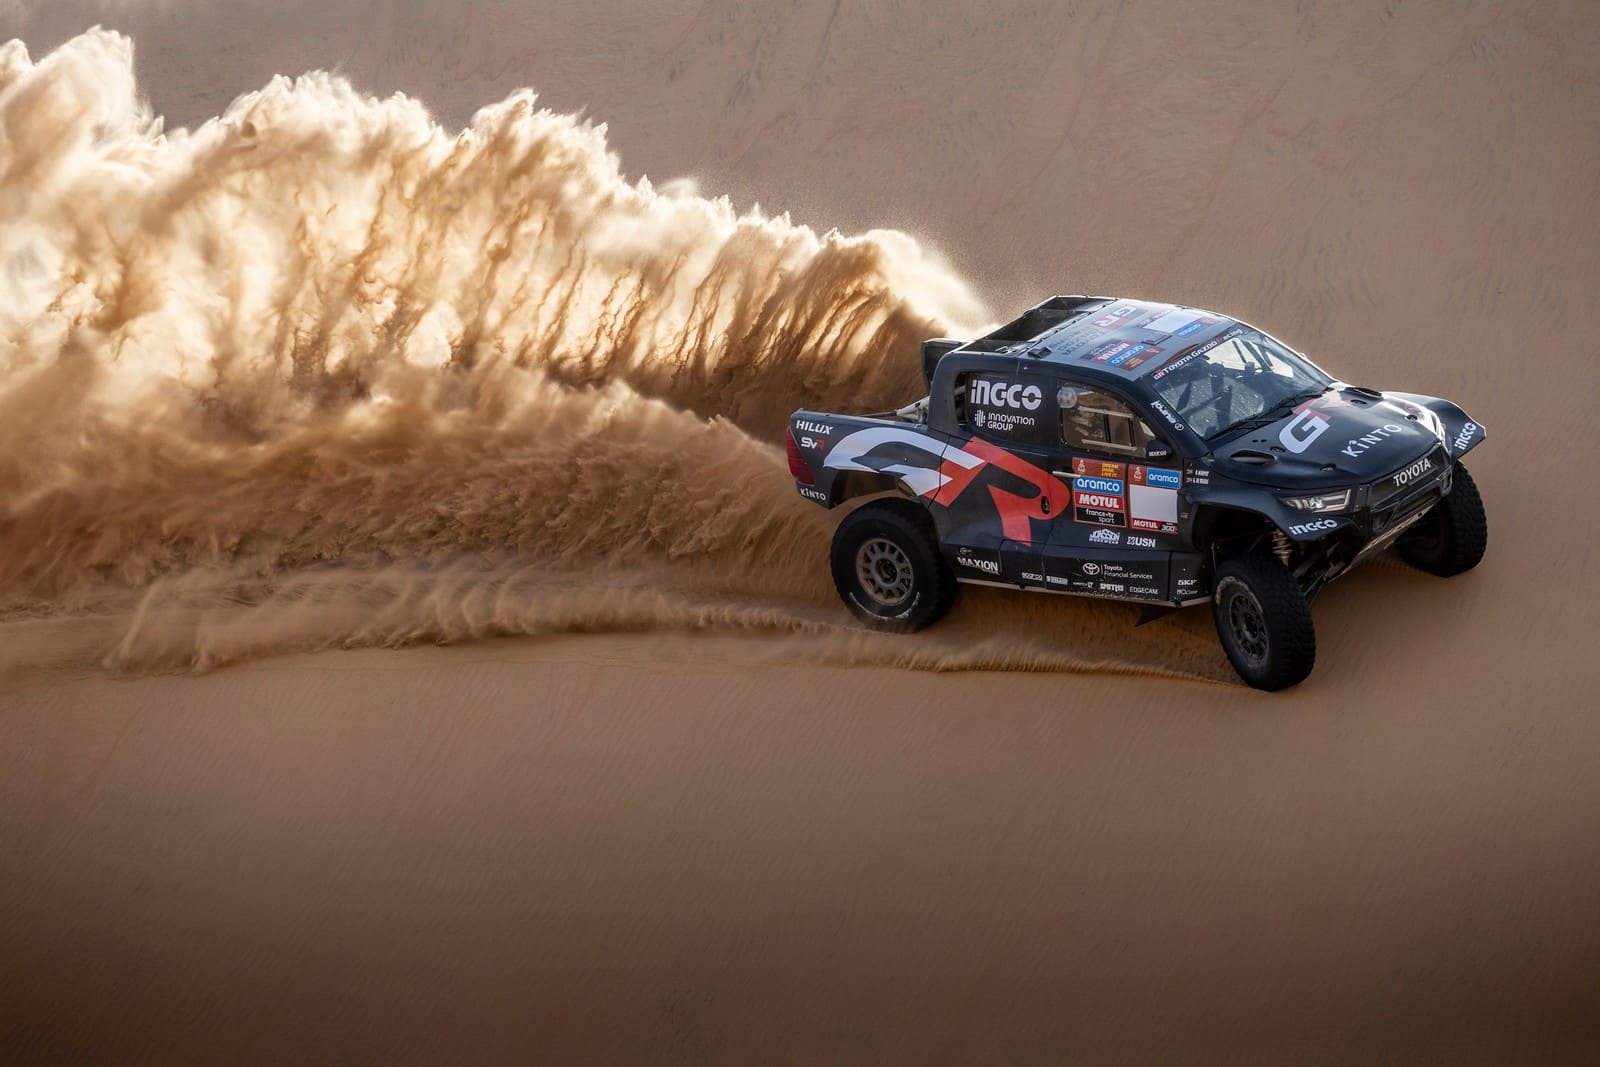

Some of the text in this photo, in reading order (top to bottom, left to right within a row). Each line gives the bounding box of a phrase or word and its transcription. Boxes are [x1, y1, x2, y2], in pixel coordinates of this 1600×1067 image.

[988, 412, 1035, 426] INNOVATION
[796, 420, 834, 435] HILUX
[988, 421, 1014, 431] GROUP
[1148, 473, 1179, 483] aramco
[1393, 458, 1432, 487] TOYOTA
[1077, 478, 1120, 492] aramco
[1079, 494, 1119, 508] MOTUL
[1133, 520, 1158, 529] MOTUL
[1135, 537, 1156, 548] USN
[957, 557, 999, 572] MAXION
[1104, 564, 1123, 572] Toyota
[1129, 572, 1153, 580] Services
